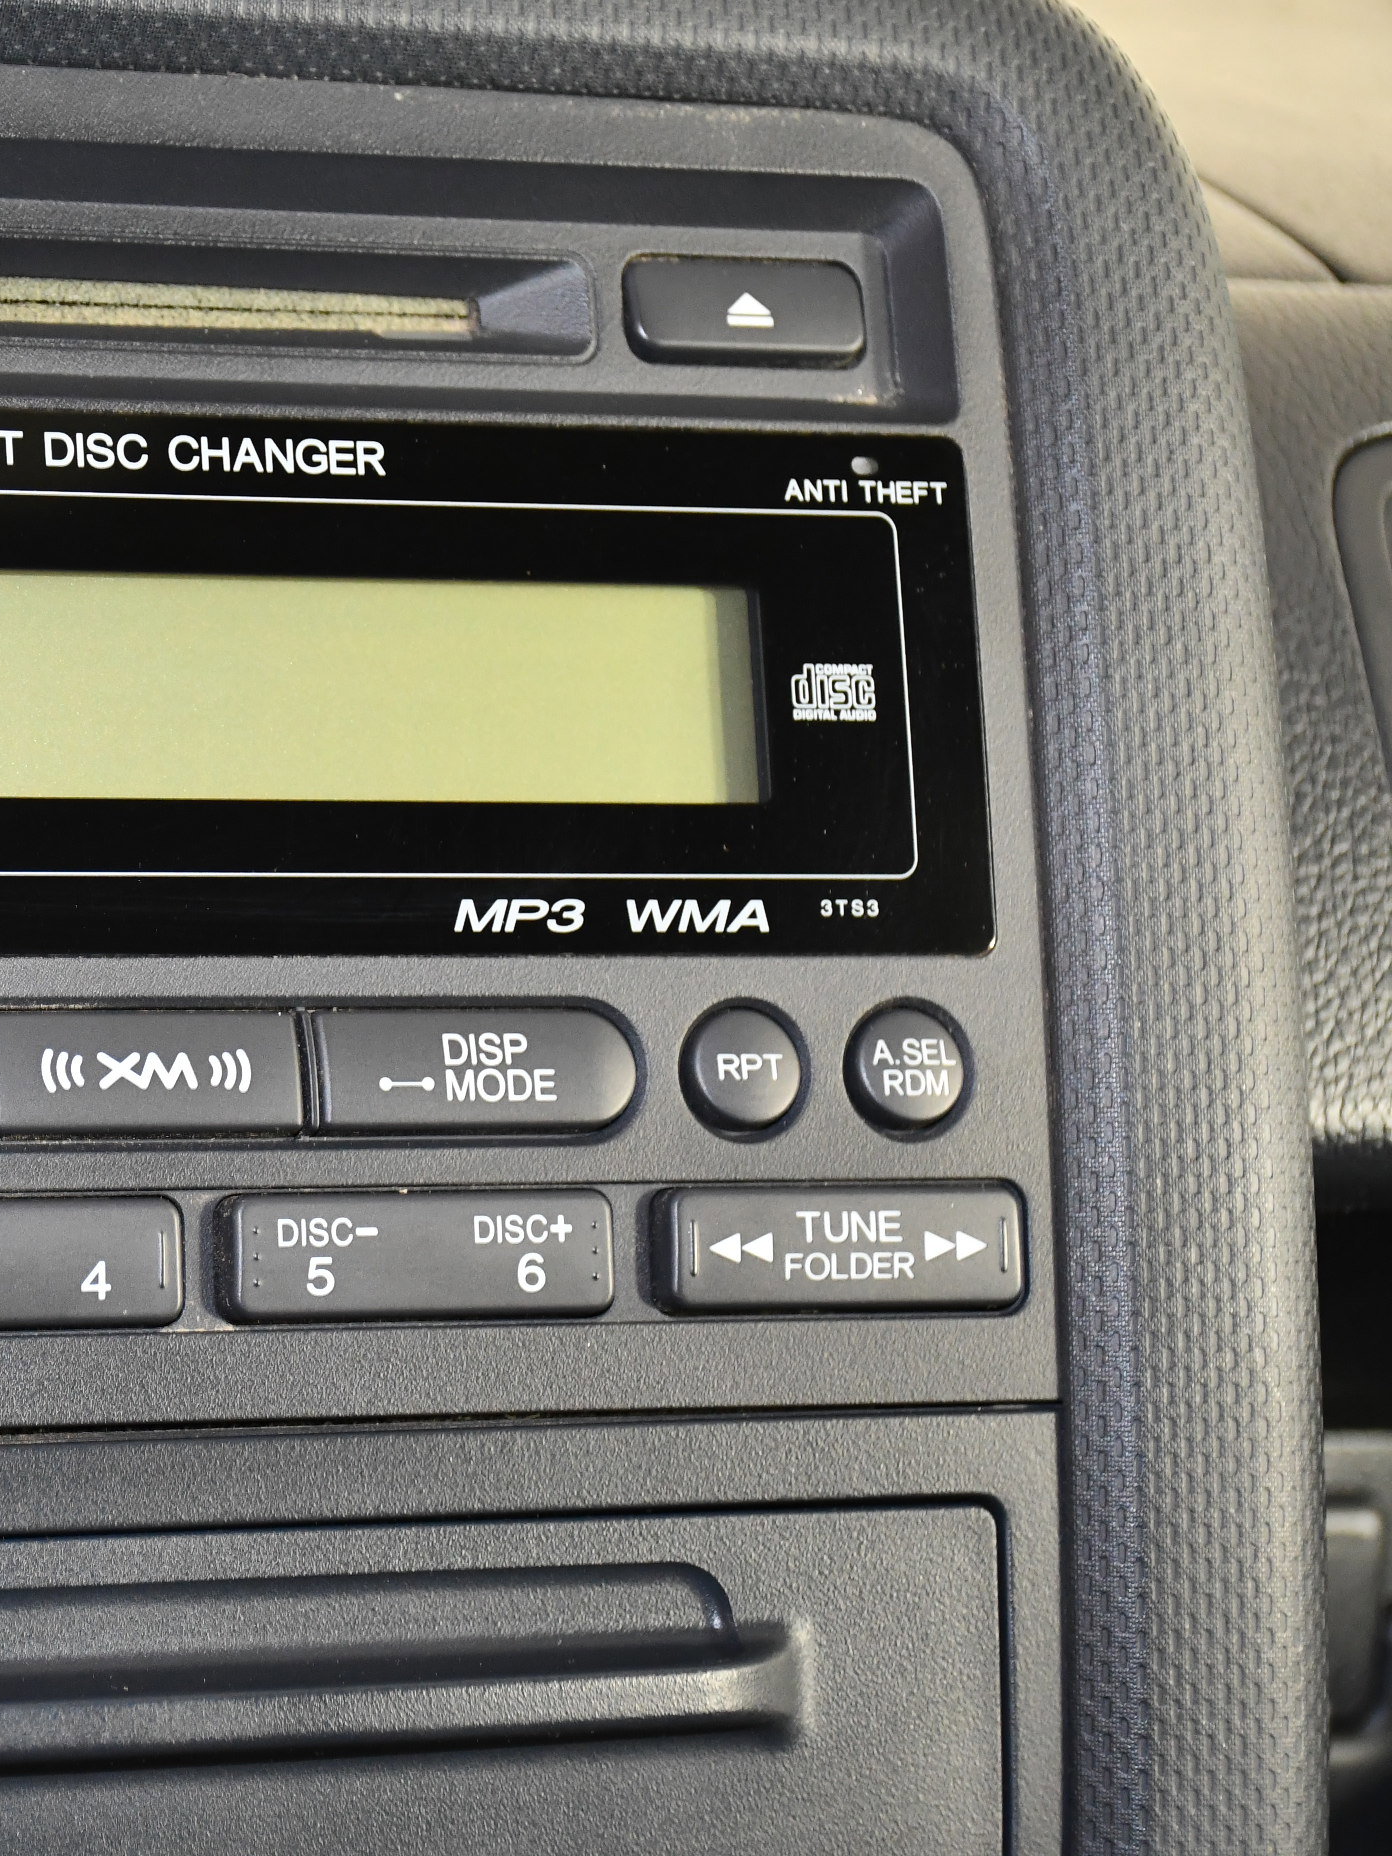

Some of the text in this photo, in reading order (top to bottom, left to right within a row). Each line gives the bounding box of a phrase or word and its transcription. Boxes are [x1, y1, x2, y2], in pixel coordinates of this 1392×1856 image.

[44, 432, 149, 470] DISC
[168, 434, 387, 477] CHANGER
[784, 478, 947, 505] ANTI THEFT
[815, 664, 873, 675] COMPACT
[793, 709, 876, 721] DIGITAL AUDIO
[454, 899, 770, 933] MP3 WMA
[820, 899, 879, 917] 3TS3
[442, 1032, 528, 1067] DISP
[872, 1039, 956, 1068] A.SEL
[717, 1052, 783, 1081] RPT
[446, 1068, 557, 1102] MODE
[883, 1069, 950, 1097] RDM
[474, 1214, 572, 1244] DISC+
[796, 1211, 902, 1244] TUNE
[80, 1260, 111, 1301] 4
[307, 1256, 336, 1297] 5
[517, 1252, 547, 1293] 6
[784, 1251, 915, 1281] FOLDER
